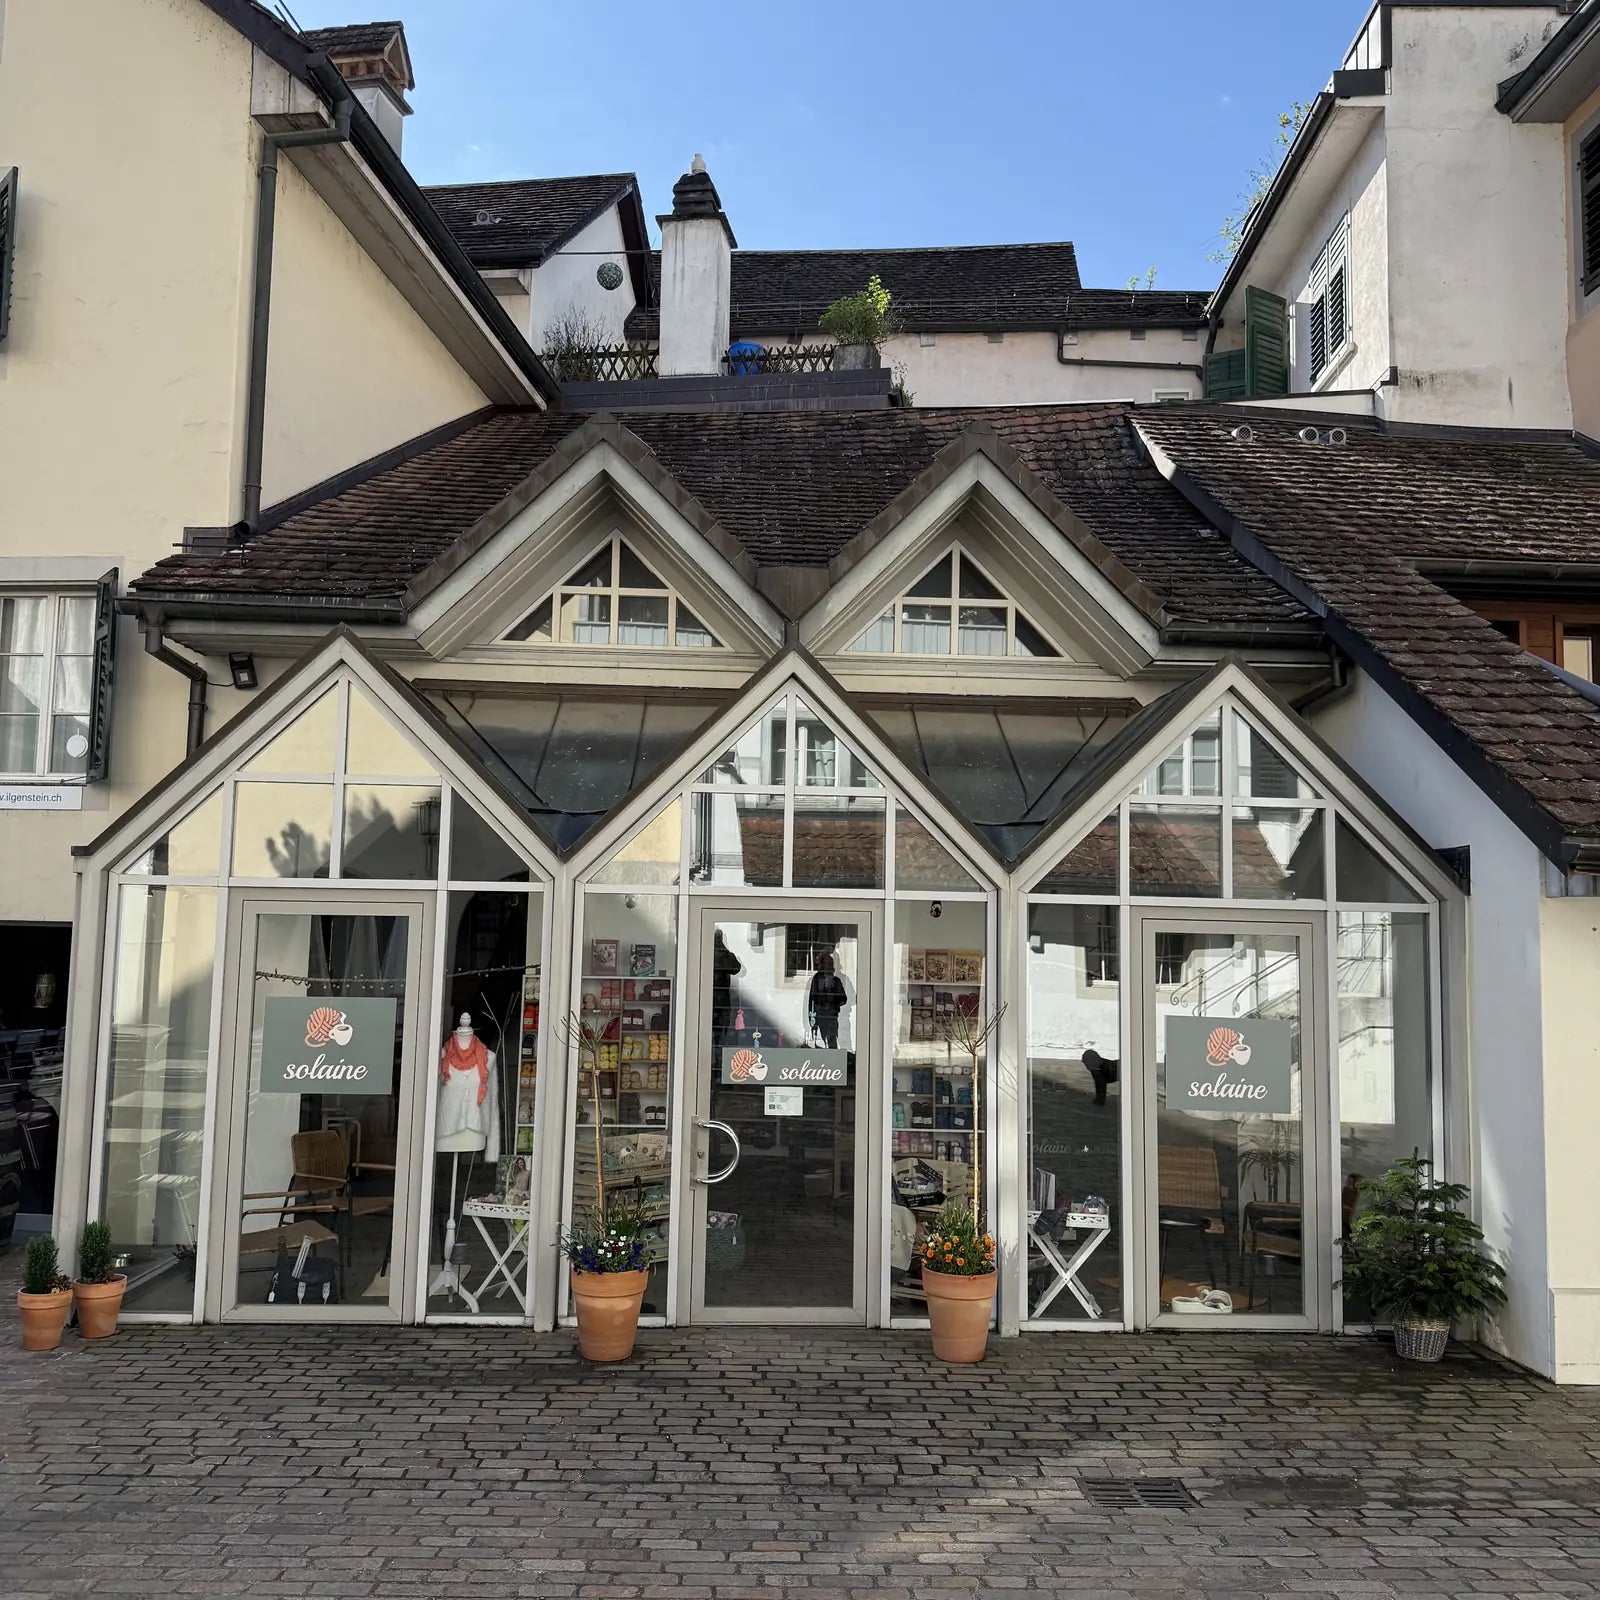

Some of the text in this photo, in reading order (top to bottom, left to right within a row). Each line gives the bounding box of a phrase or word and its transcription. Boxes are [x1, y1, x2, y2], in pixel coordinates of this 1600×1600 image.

[283, 1053, 369, 1081] solaine
[779, 1060, 842, 1081] solaine
[1187, 1072, 1269, 1100] solaine
[1033, 1136, 1072, 1154] olaine
